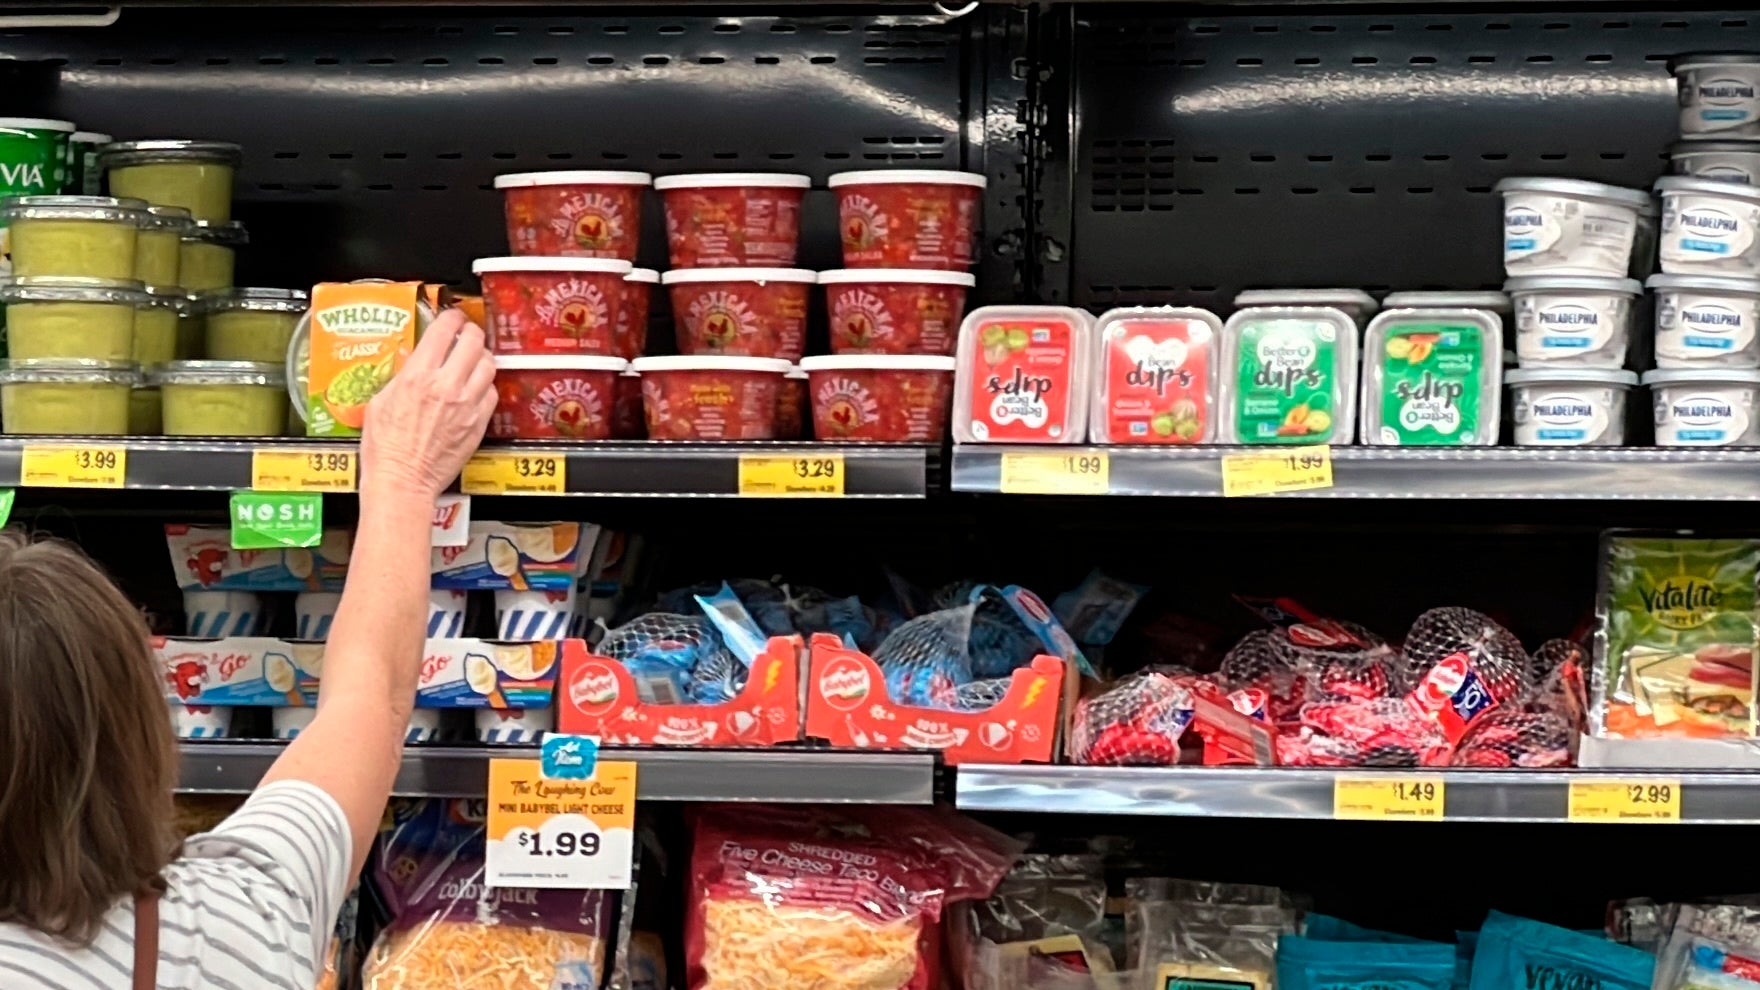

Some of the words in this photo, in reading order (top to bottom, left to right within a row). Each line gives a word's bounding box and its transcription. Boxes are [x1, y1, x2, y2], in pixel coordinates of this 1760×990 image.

[1680, 212, 1738, 233] PHILADELPHIA
[545, 279, 609, 326] MEXICANA
[321, 306, 408, 328] WHOLLY
[1539, 311, 1598, 326] PHILADELPHIA
[1682, 311, 1741, 327] PHILADELPHIA
[987, 367, 1052, 403] dips
[1126, 361, 1194, 396] dips
[1254, 361, 1322, 396] dips
[1398, 372, 1463, 407] dips
[1534, 404, 1593, 418] PHILADELPHIA
[1673, 404, 1732, 419] PHILADELPHIA
[308, 453, 349, 472] $3.99
[237, 504, 315, 520] NOSH
[511, 781, 531, 795] The
[590, 783, 616, 796] Cow
[1392, 782, 1435, 803] $1.49
[521, 804, 561, 814] BABYBEL
[591, 804, 624, 815] CHEESE
[518, 832, 600, 857] $1.99
[789, 841, 877, 866] SHREDDED
[719, 840, 758, 862] Five
[761, 849, 833, 874] Cheese
[840, 862, 879, 882] Taco
